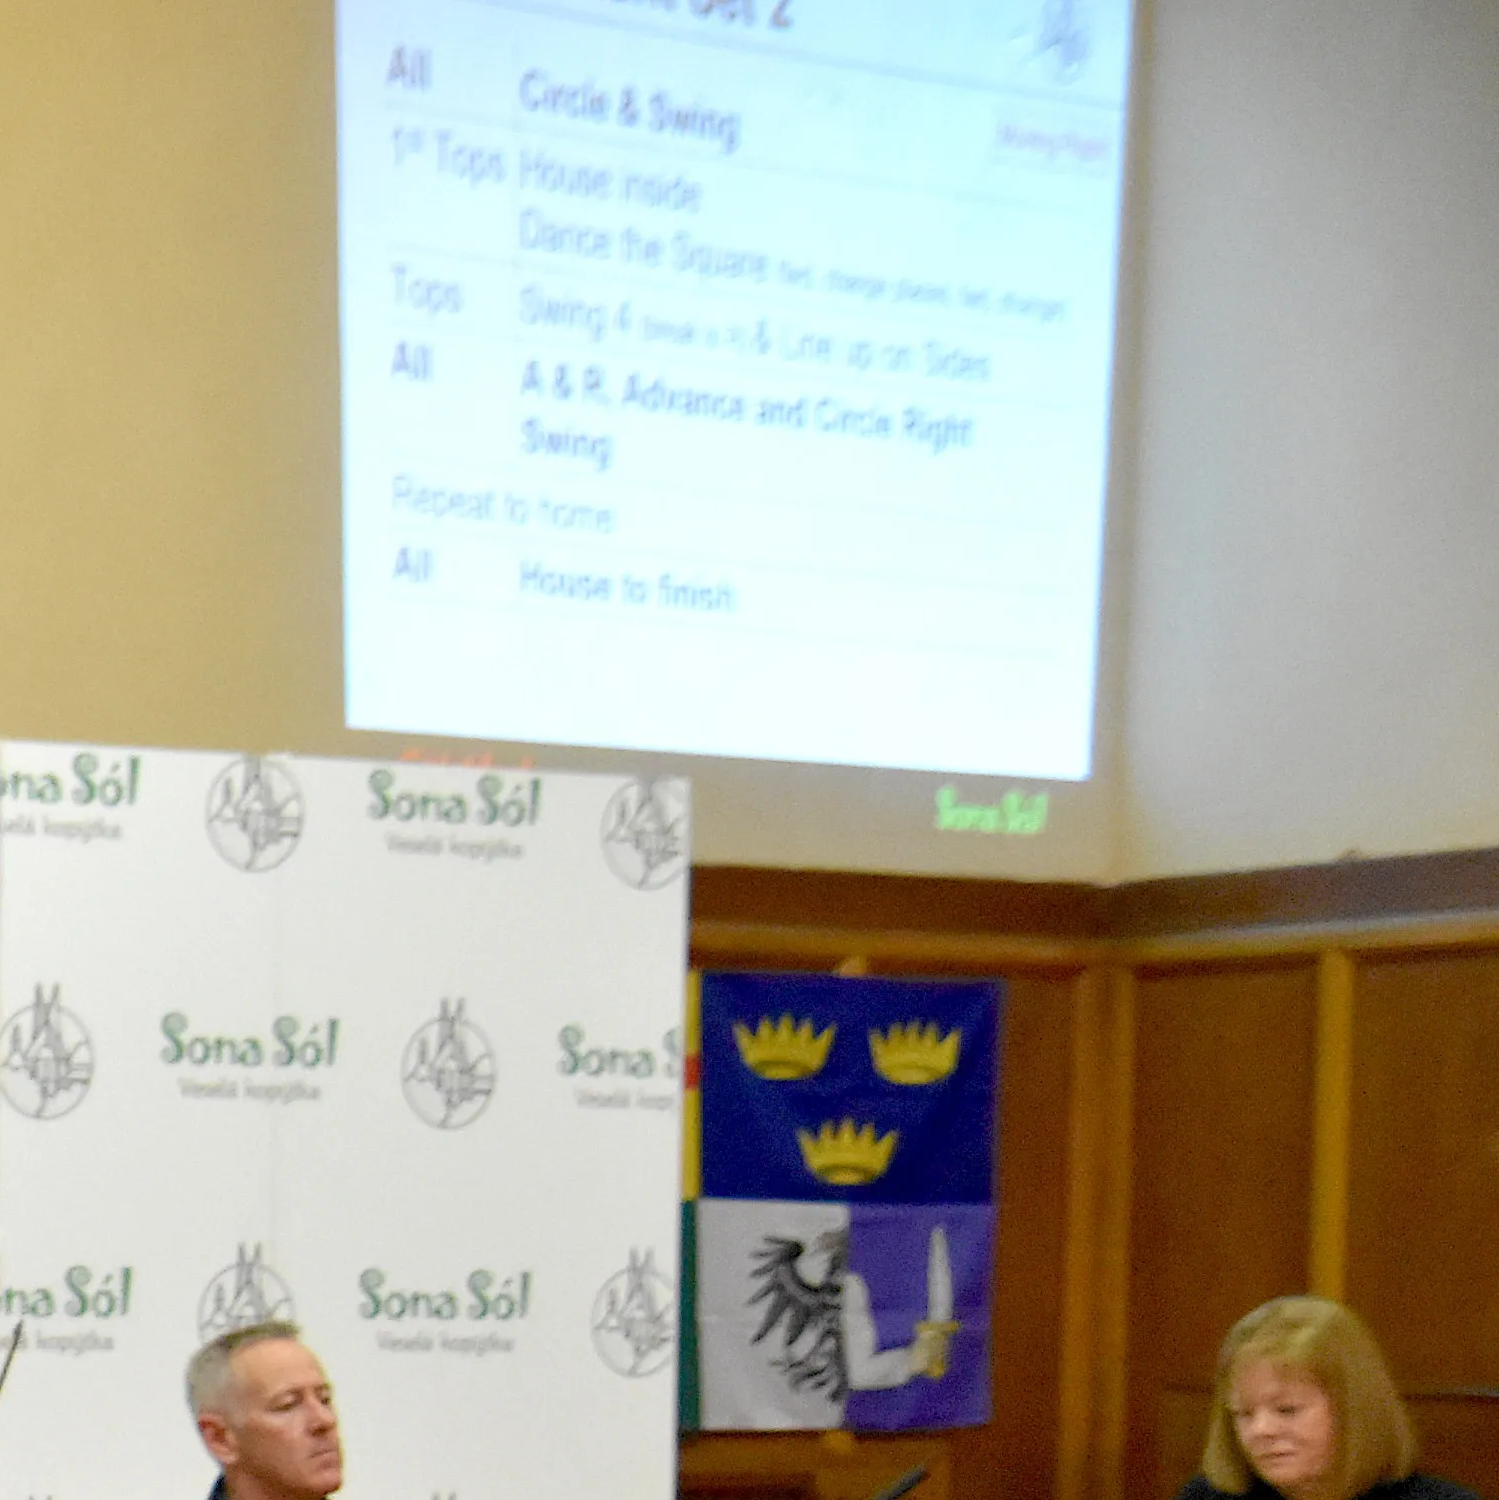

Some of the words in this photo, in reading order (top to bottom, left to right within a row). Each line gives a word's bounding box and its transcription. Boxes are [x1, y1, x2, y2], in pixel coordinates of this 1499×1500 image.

[387, 45, 432, 92] All
[519, 67, 609, 123] Circle
[617, 84, 641, 128] &
[648, 89, 743, 155] Swing
[433, 128, 507, 189] Tops
[519, 146, 613, 201] House
[519, 205, 611, 260] Dance
[670, 230, 769, 284] Square
[391, 263, 463, 314] Tops
[519, 284, 607, 342] Swing
[391, 340, 433, 382] All
[519, 359, 544, 397] A
[553, 362, 575, 400] &
[622, 373, 745, 422] Advance
[757, 397, 806, 430] and
[903, 406, 976, 455] Right
[519, 416, 613, 472] Swing
[391, 472, 496, 520] Repeat
[392, 546, 433, 583] All
[519, 558, 613, 600] House
[658, 572, 738, 612] finish
[70, 752, 141, 806] Sól
[366, 768, 468, 825] Sona
[475, 773, 542, 827] Sól
[159, 1012, 264, 1069] Sona
[272, 1015, 341, 1069] Sól
[556, 1025, 656, 1079] Sona
[64, 1265, 134, 1319] Sól
[358, 1268, 459, 1321] Sona
[466, 1268, 533, 1321] Sól
